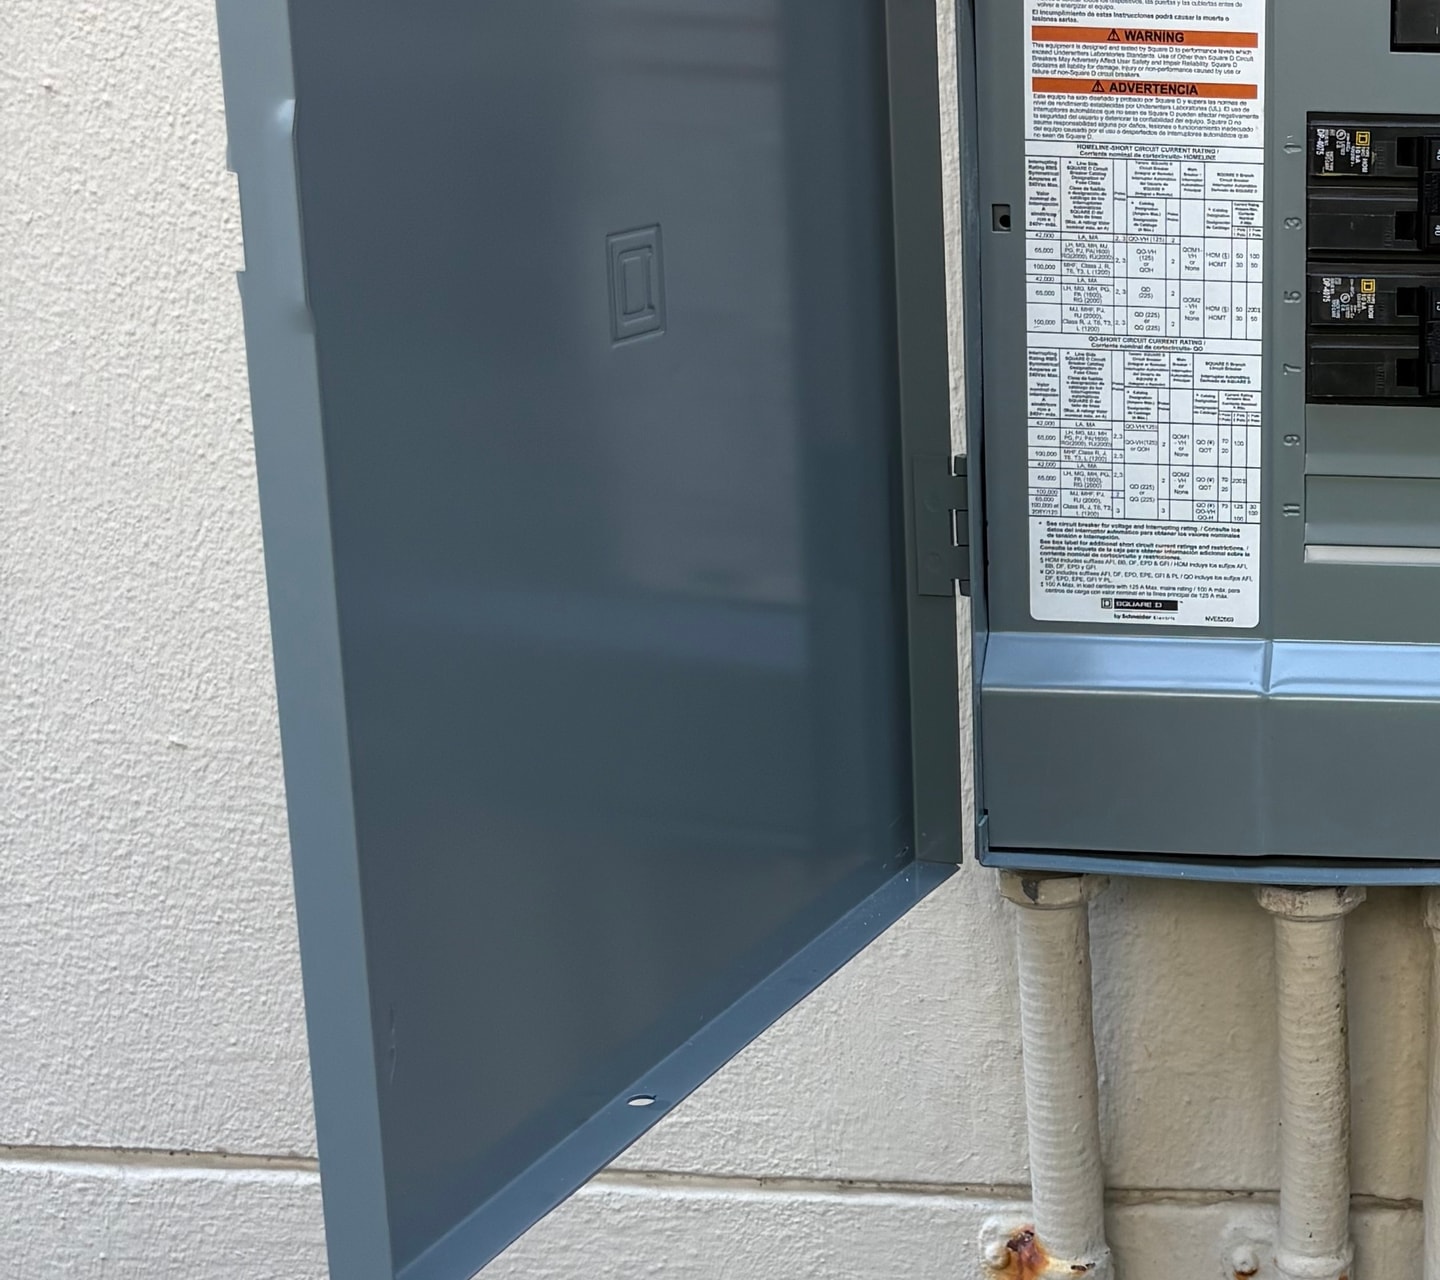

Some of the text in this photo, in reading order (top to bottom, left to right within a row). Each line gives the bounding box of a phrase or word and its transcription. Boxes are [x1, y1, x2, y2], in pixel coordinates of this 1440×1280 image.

[1125, 31, 1184, 43] WARNING
[1110, 84, 1198, 96] ADVERTENCIA
[1284, 144, 1302, 154] 1
[1284, 217, 1302, 230] 3
[1284, 290, 1302, 304] 5
[1283, 363, 1301, 375] 7
[1284, 434, 1300, 446] 9
[1283, 504, 1300, 517] 11
